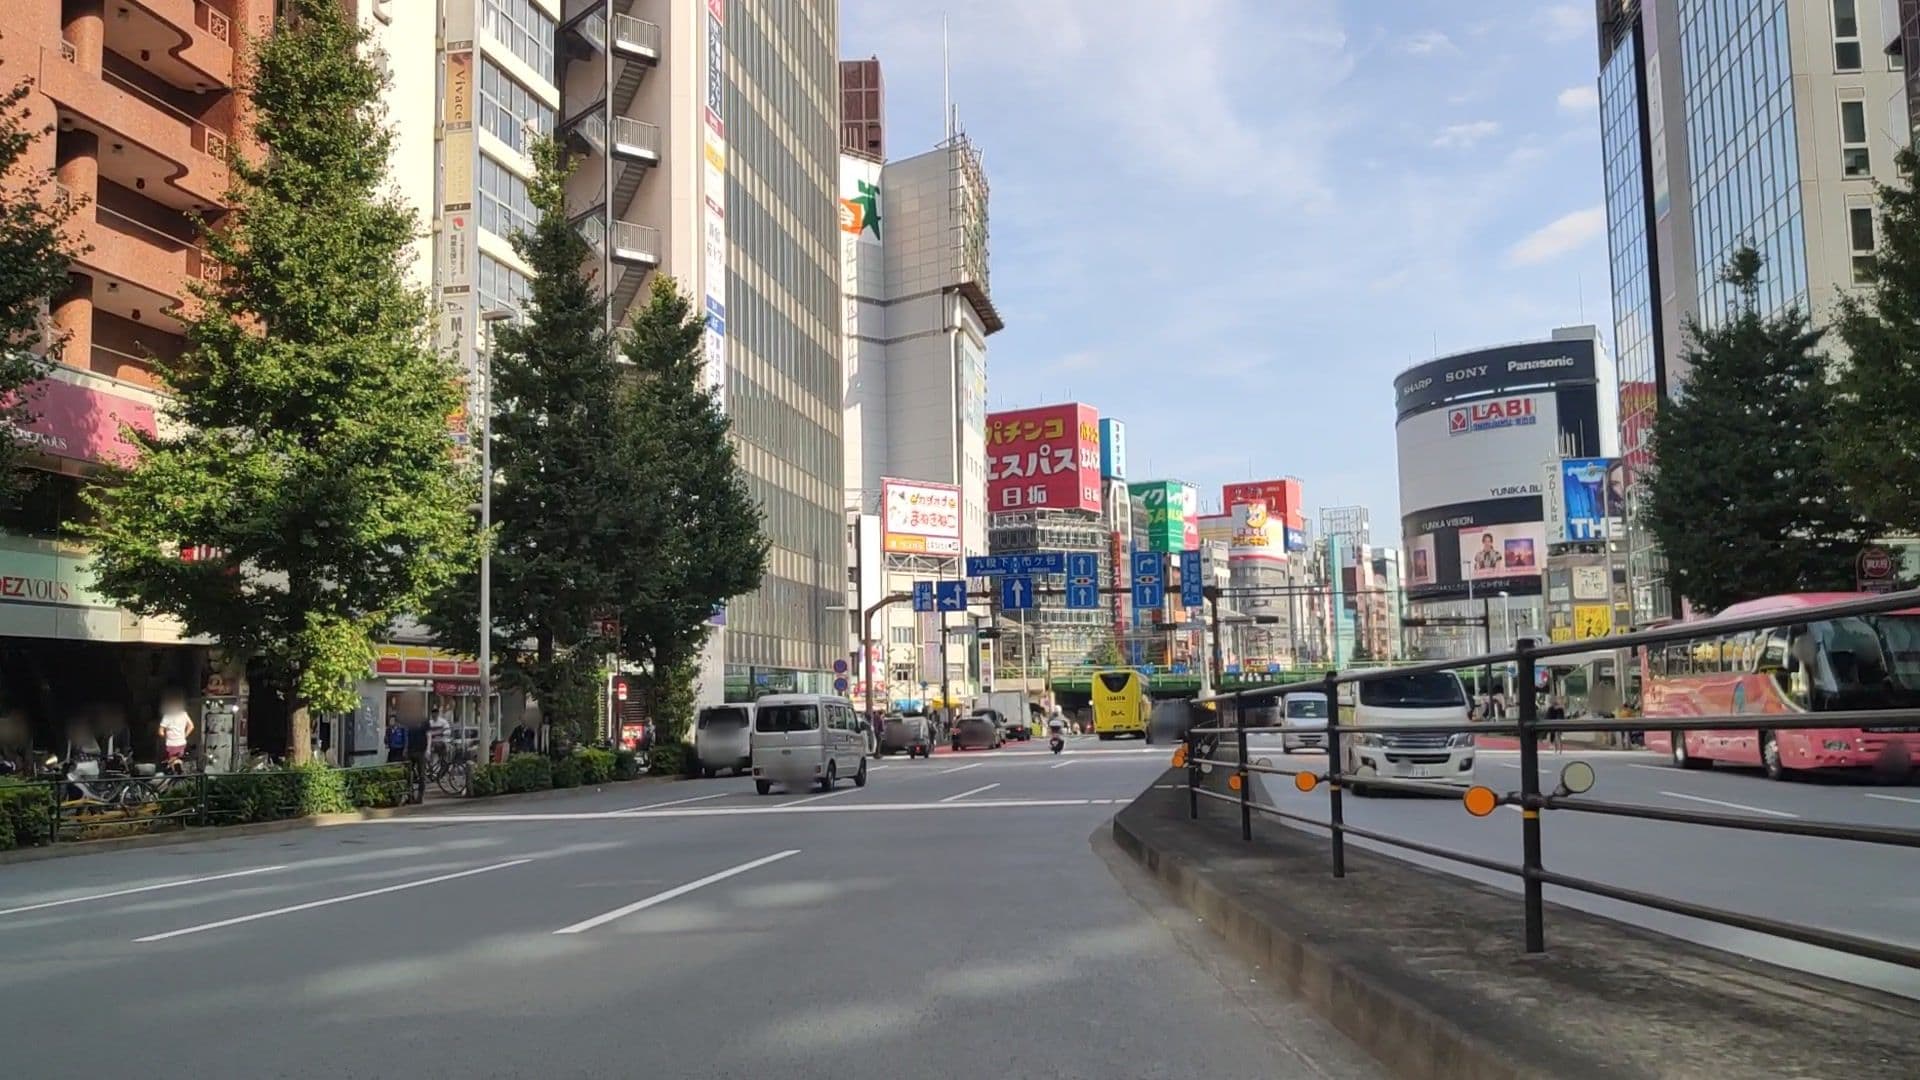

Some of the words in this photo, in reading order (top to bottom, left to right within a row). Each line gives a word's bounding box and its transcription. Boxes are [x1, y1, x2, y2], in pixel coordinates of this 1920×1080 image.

[454, 69, 465, 120] Vivace
[1445, 365, 1488, 383] SONY
[1507, 355, 1574, 372] Panasonic
[1403, 378, 1433, 395] SHARP
[1471, 397, 1532, 421] LABI
[985, 418, 1065, 446] パチンコ
[986, 444, 1078, 481] エスパス
[1002, 484, 1047, 507] 日拓
[1490, 486, 1527, 496] YUNIKA
[910, 510, 957, 528] まねきねこ
[1446, 515, 1474, 527] VISION
[1570, 516, 1624, 540] THE
[0, 576, 70, 602] EZVOUS
